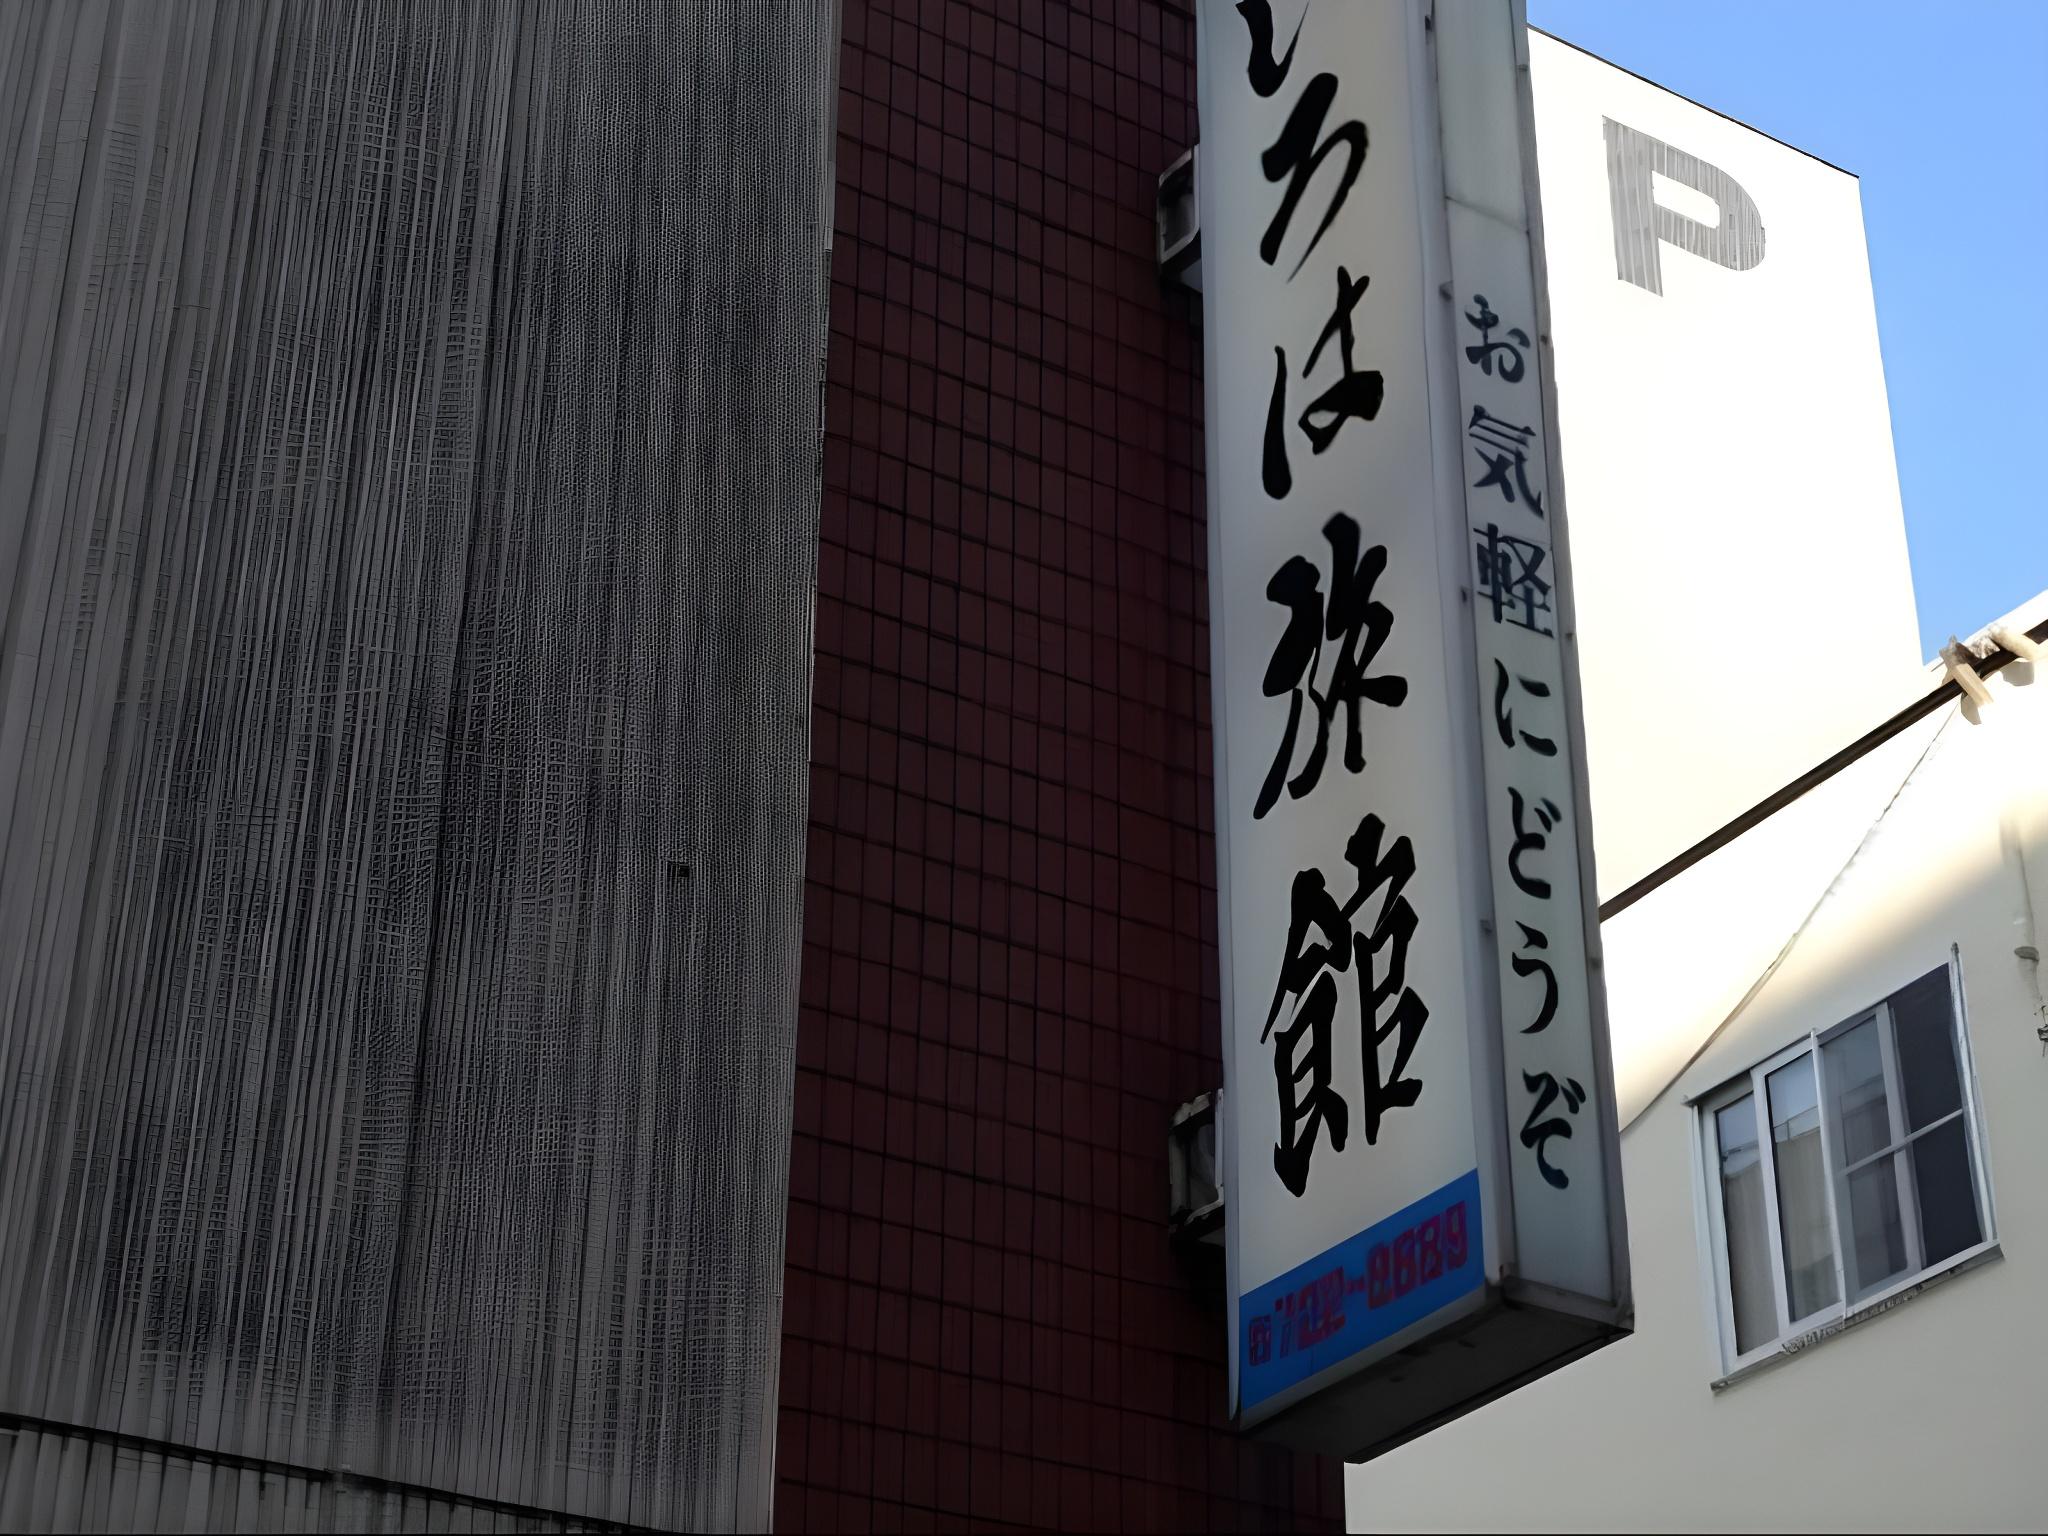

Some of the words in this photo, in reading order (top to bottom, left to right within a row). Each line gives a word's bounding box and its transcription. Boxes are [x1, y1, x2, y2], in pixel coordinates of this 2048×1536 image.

[1602, 115, 1765, 297] P
[1465, 295, 1586, 1189] お気軽にどうぞ
